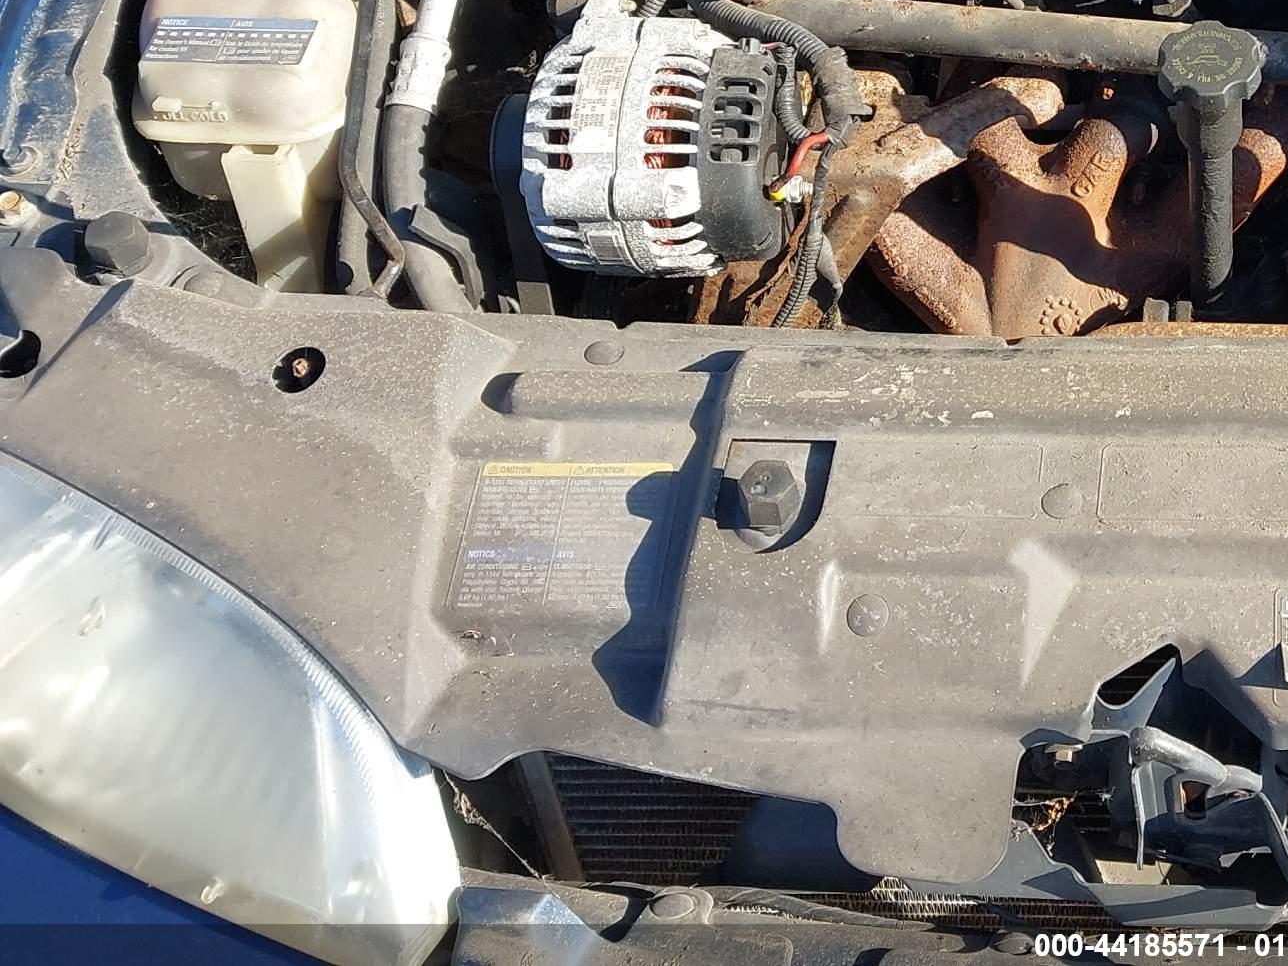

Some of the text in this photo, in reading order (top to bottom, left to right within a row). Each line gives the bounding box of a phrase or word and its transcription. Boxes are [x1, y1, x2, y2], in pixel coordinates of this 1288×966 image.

[161, 18, 189, 26] NOTICE
[190, 110, 229, 122] COLD
[500, 466, 532, 475] CAUTION
[586, 466, 625, 474] ATTENTION
[556, 550, 575, 559] AVIS
